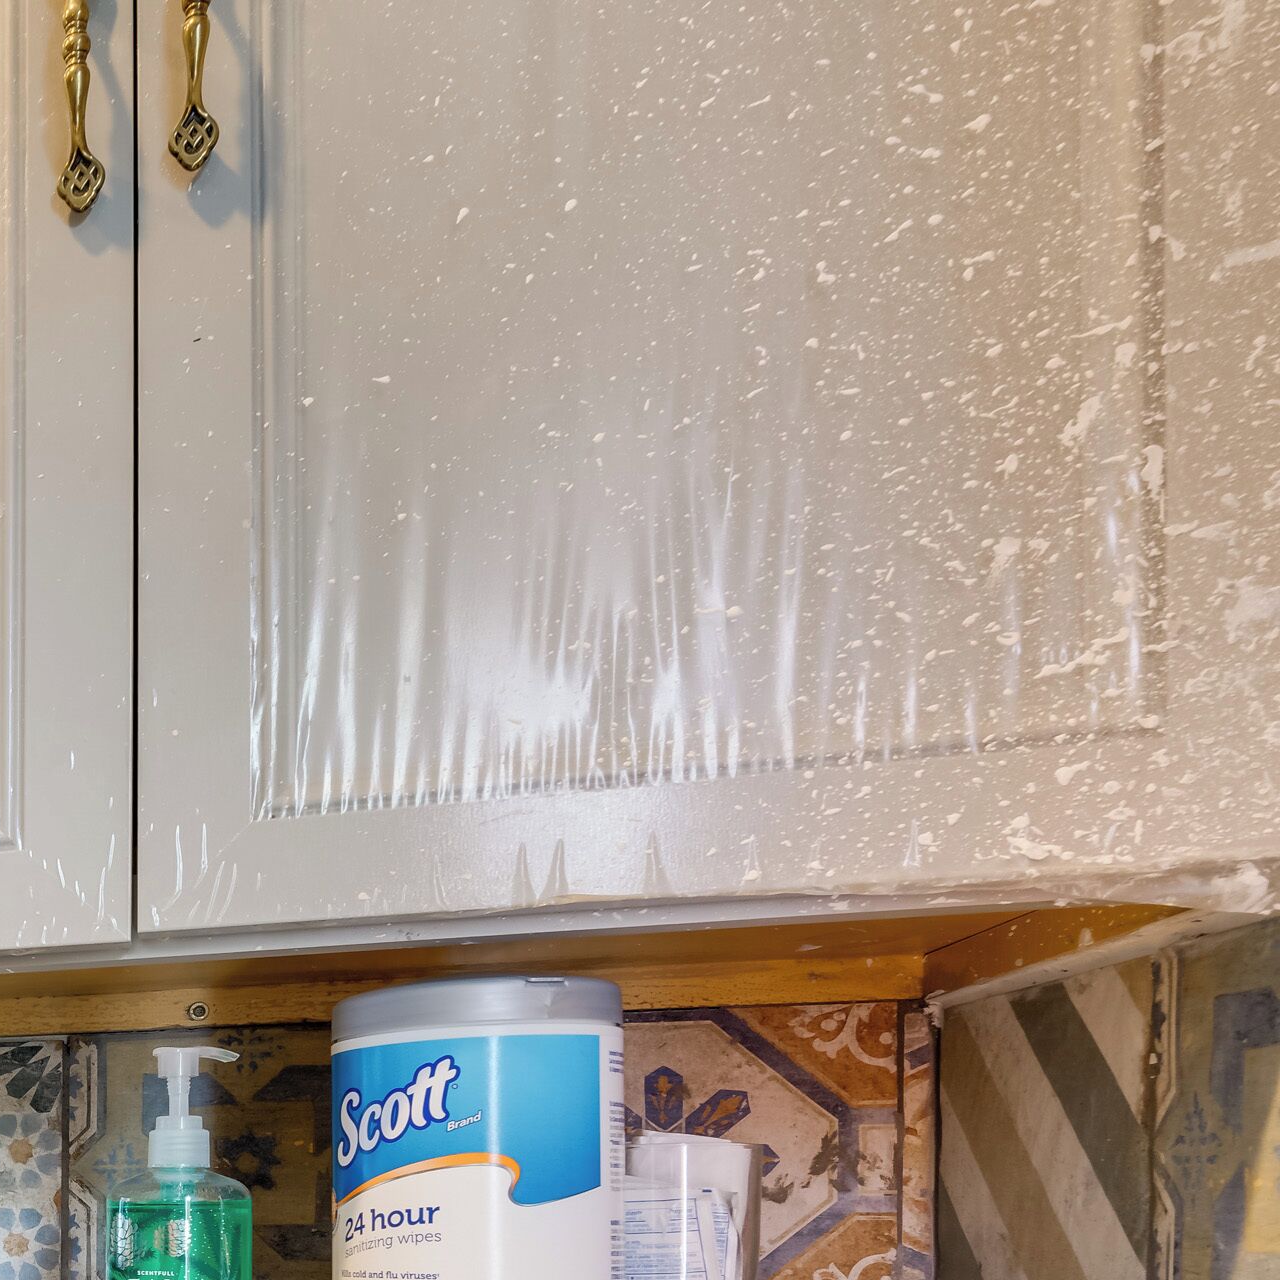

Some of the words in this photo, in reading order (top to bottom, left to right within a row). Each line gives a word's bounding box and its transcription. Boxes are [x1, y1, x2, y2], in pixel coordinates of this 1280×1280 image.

[337, 1057, 459, 1167] Scott
[446, 1110, 482, 1132] Brand
[345, 1212, 365, 1242] 24
[370, 1206, 440, 1231] hour
[345, 1236, 393, 1258] sanitizing
[398, 1232, 441, 1245] wipes
[352, 1270, 366, 1278] cold
[368, 1271, 383, 1279] and
[386, 1271, 398, 1279] flu
